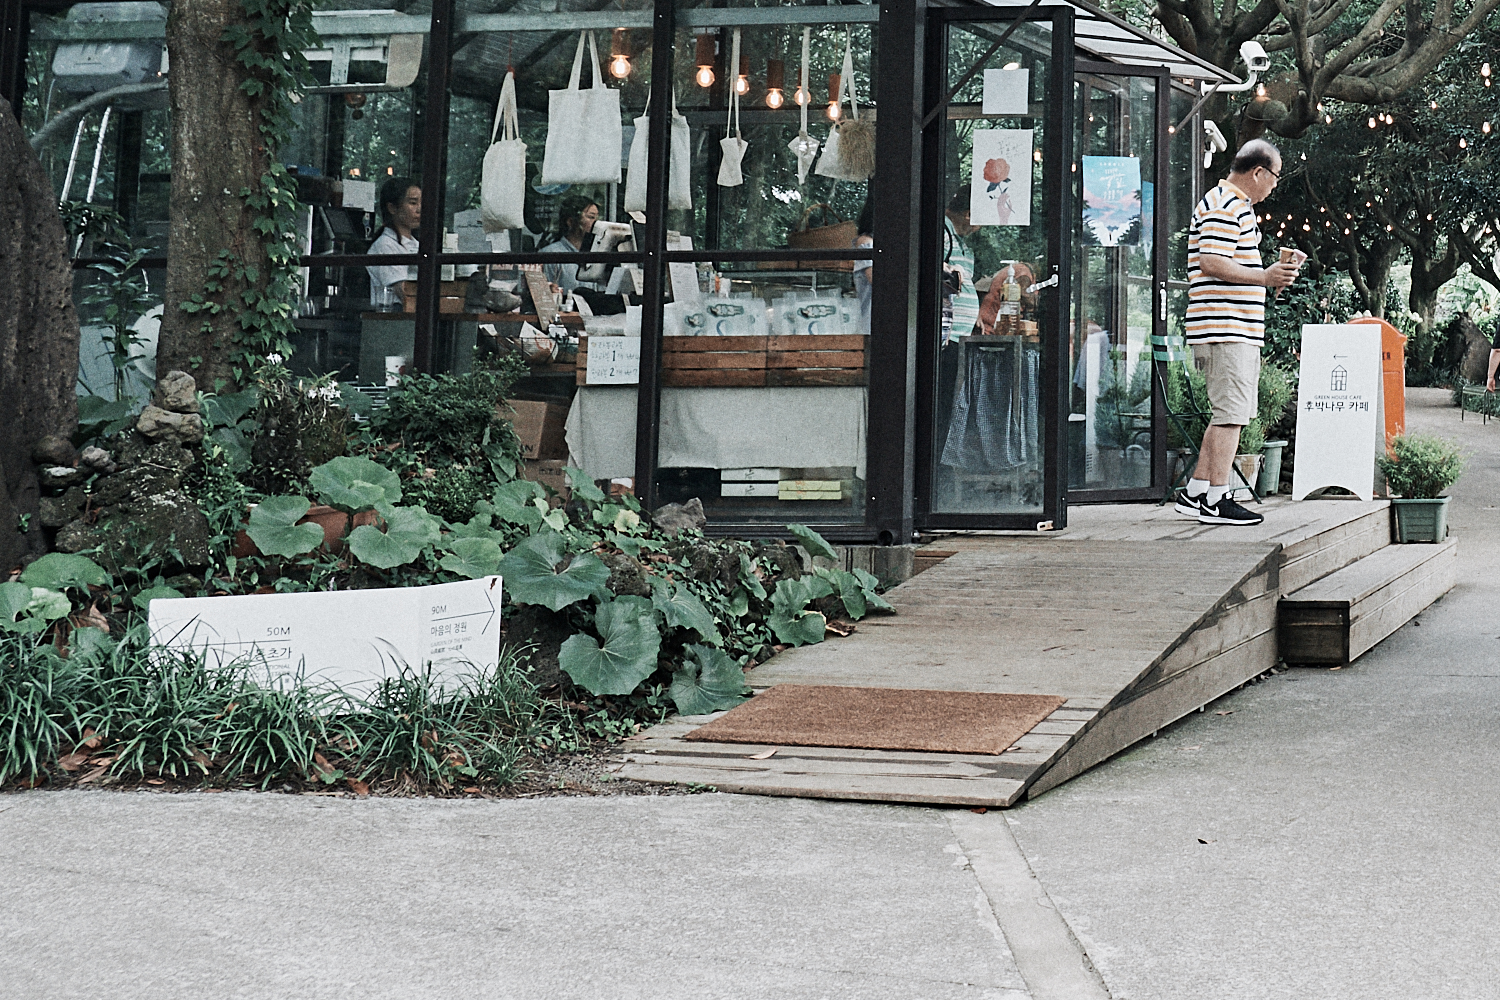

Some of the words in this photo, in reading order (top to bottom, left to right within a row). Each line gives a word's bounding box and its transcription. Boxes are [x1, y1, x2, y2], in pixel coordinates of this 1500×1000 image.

[1304, 401, 1345, 412] 후박나무
[1349, 401, 1369, 412] 카페
[431, 605, 447, 615] 90M
[266, 626, 291, 637] 50M
[430, 623, 452, 637] 마음의
[454, 621, 468, 634] 정원
